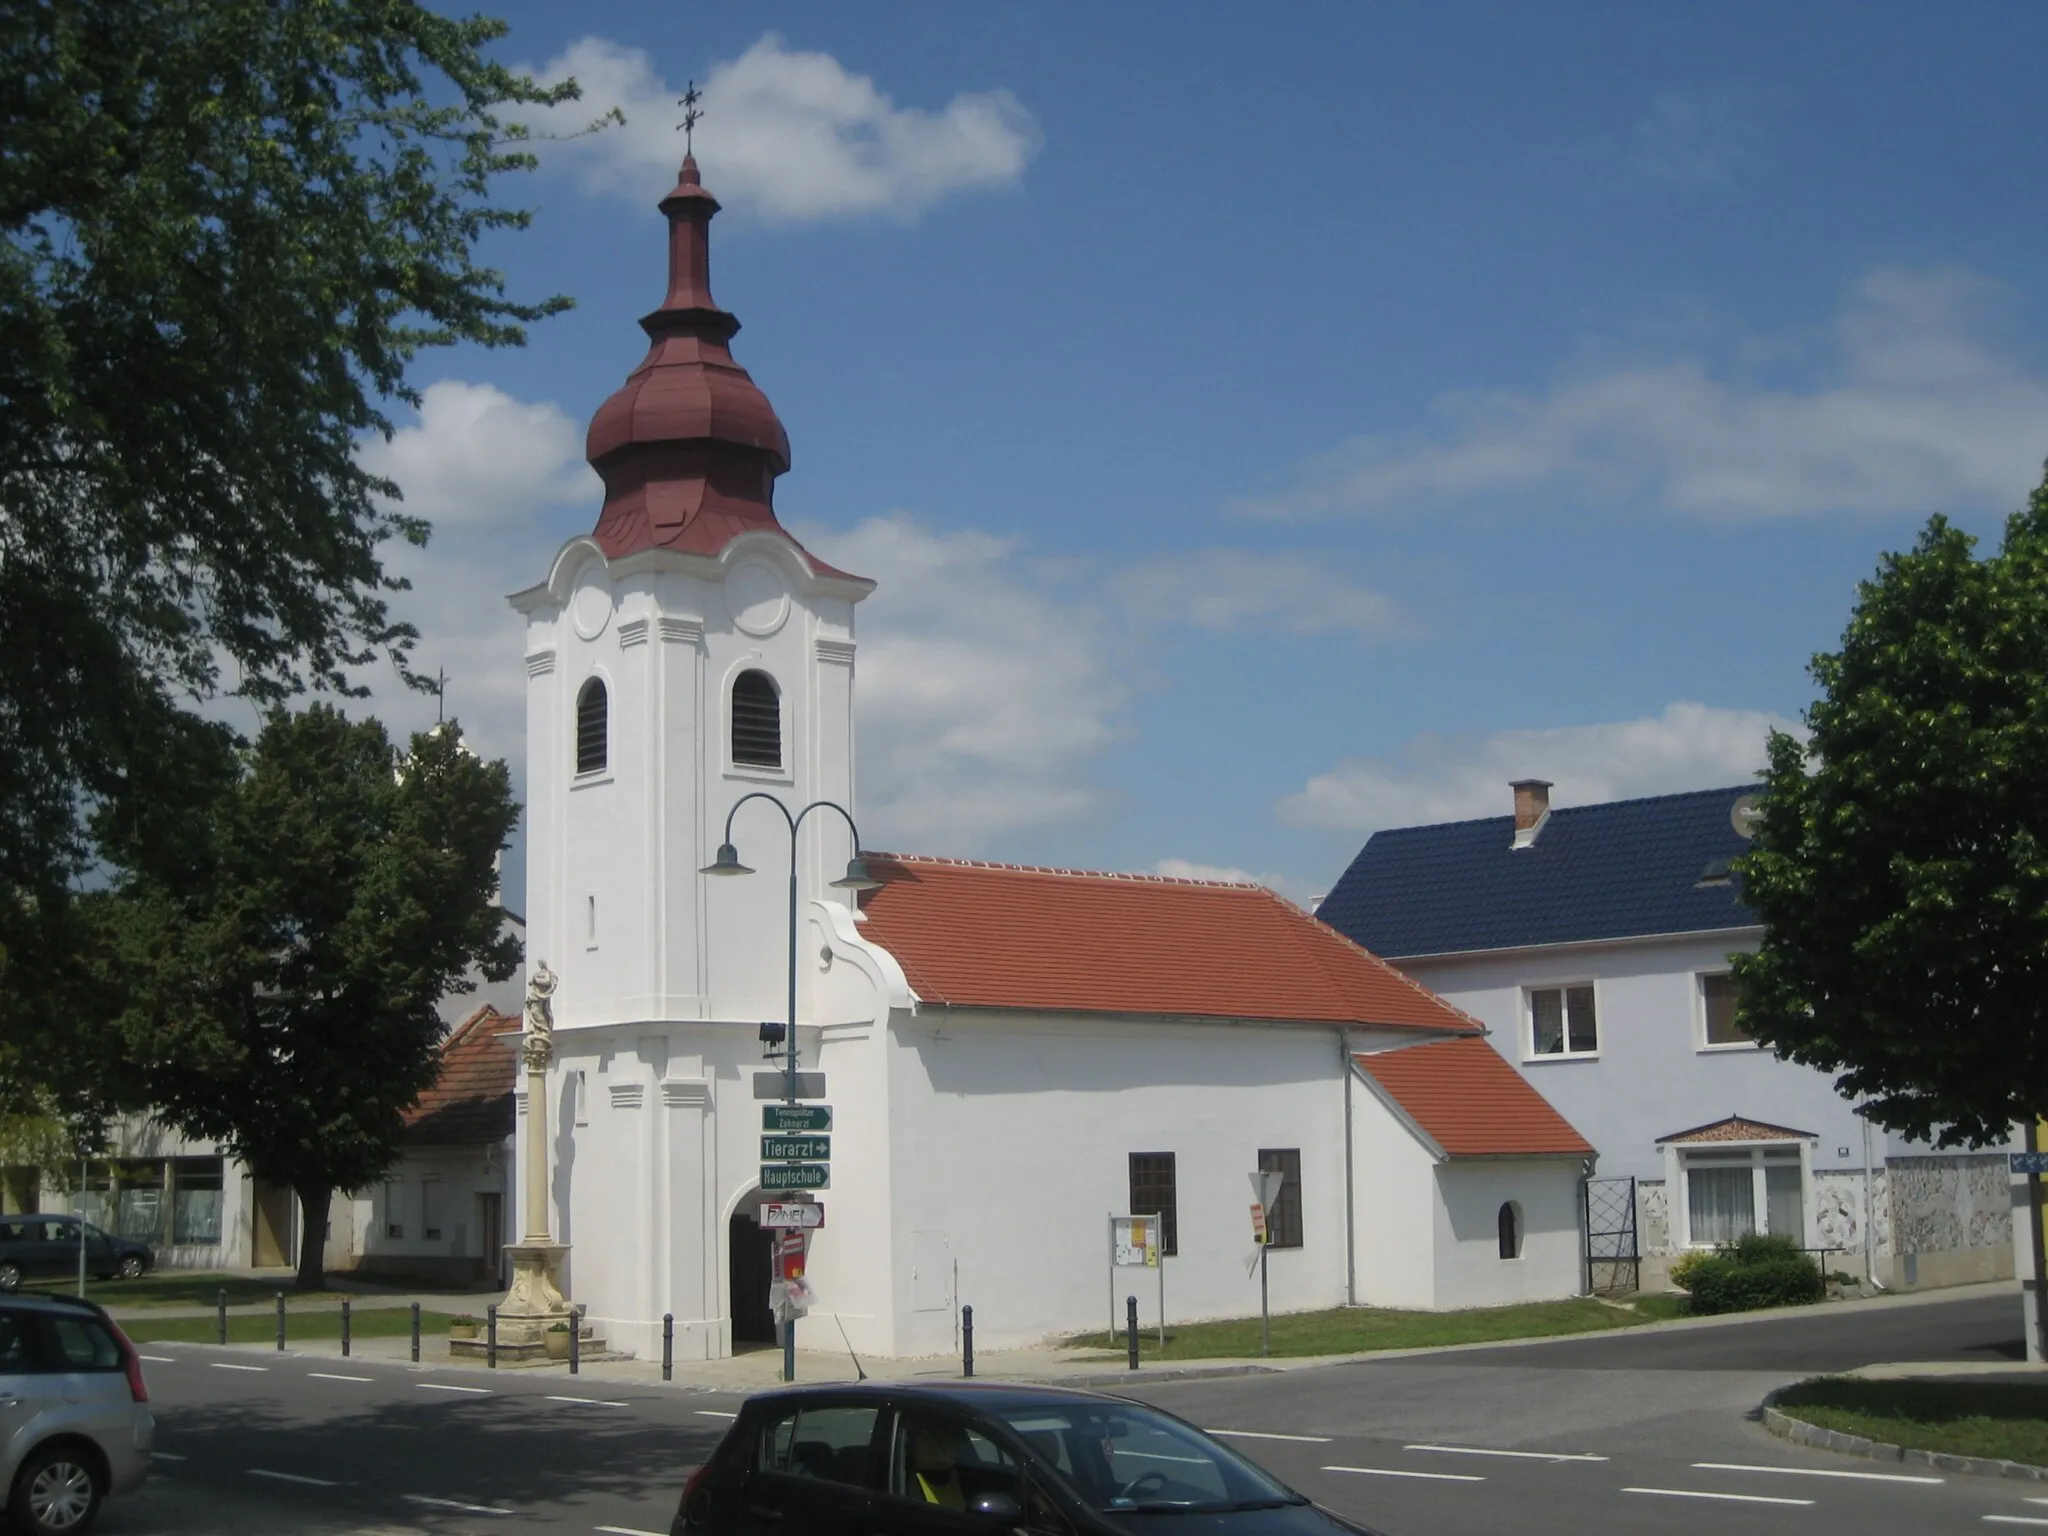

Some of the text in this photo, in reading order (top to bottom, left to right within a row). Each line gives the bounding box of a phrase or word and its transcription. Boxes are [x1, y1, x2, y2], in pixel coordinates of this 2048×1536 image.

[779, 1118, 810, 1128] Zahnarzt
[764, 1139, 814, 1157] Tierarzt
[764, 1168, 821, 1188] Hauptschule
